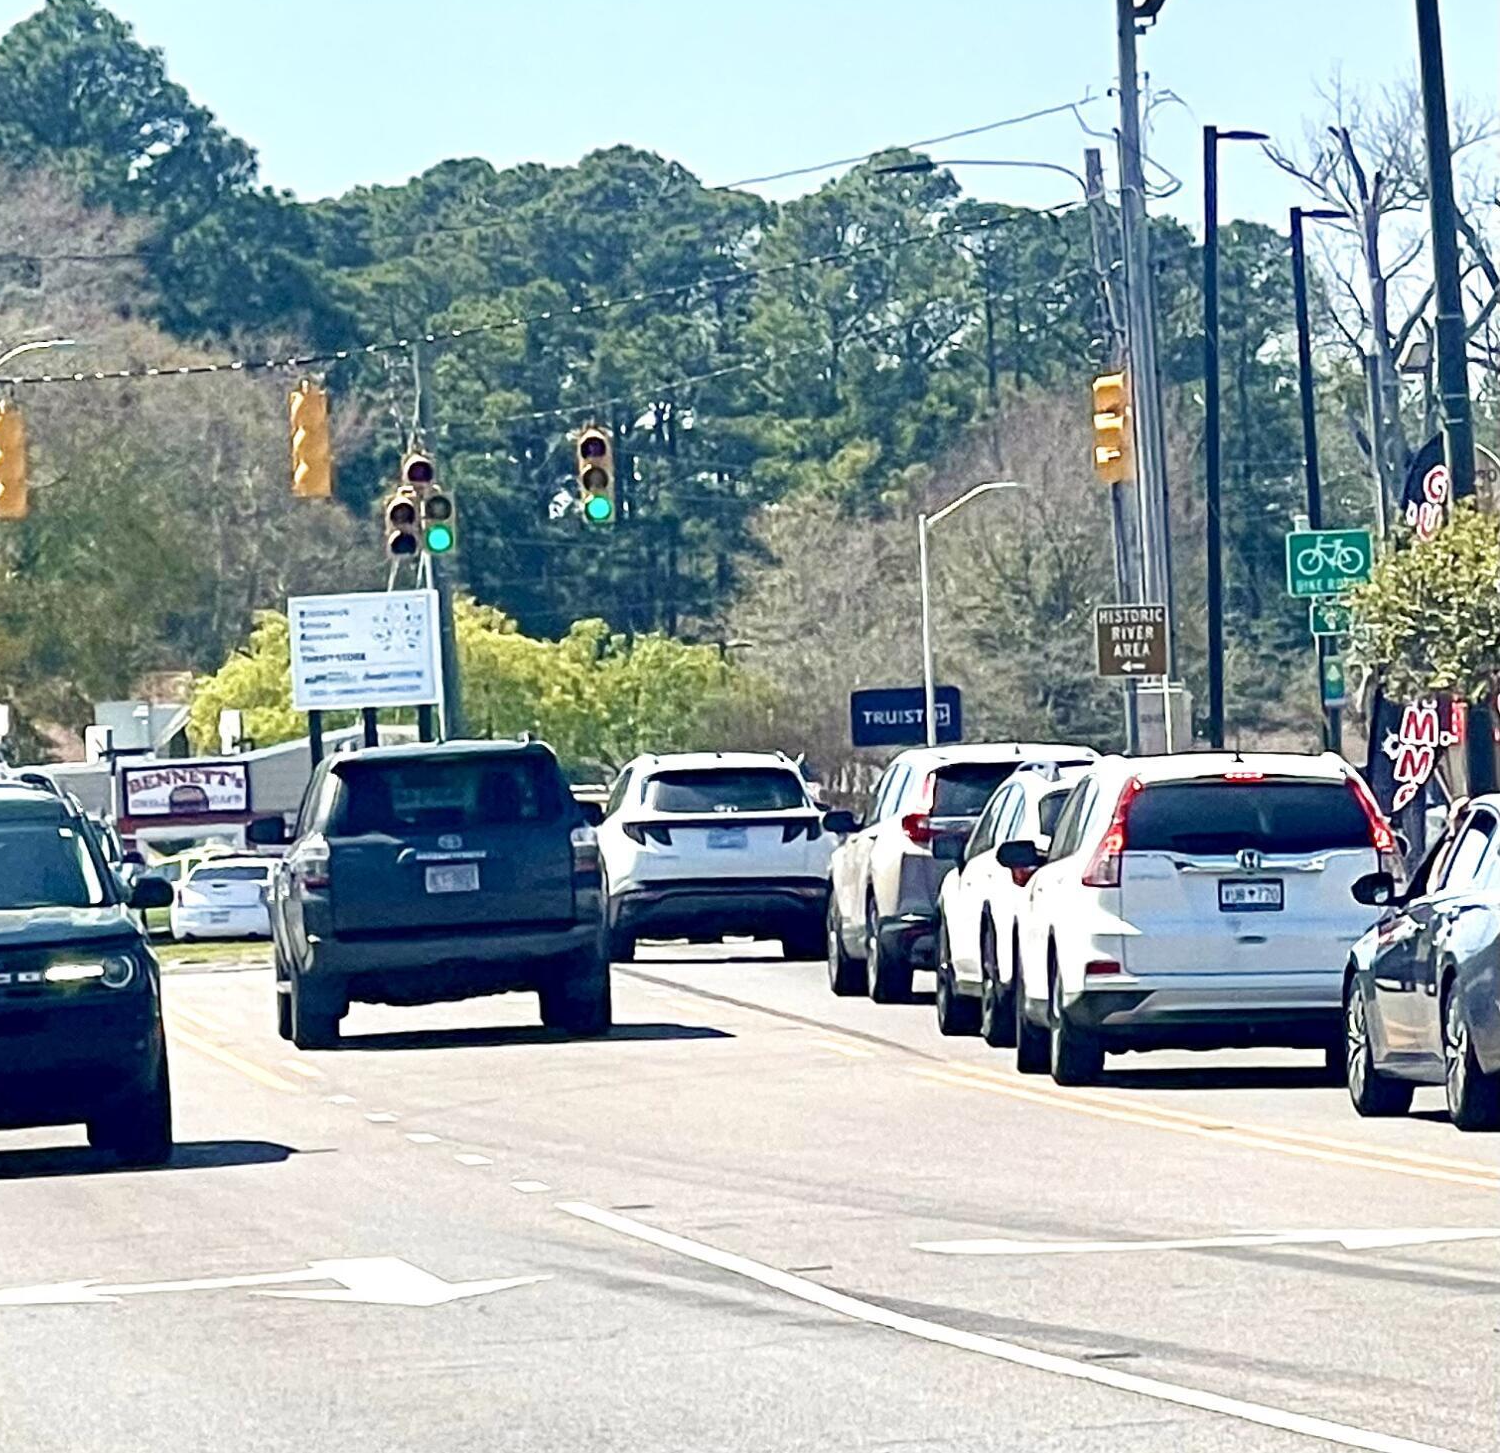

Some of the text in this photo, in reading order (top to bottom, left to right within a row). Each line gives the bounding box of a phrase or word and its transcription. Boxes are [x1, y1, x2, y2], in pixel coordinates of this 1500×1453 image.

[1099, 609, 1163, 624] HISTORIC
[1111, 625, 1154, 641] RIVER
[1113, 642, 1151, 657] AREA
[862, 708, 924, 724] TRUIST
